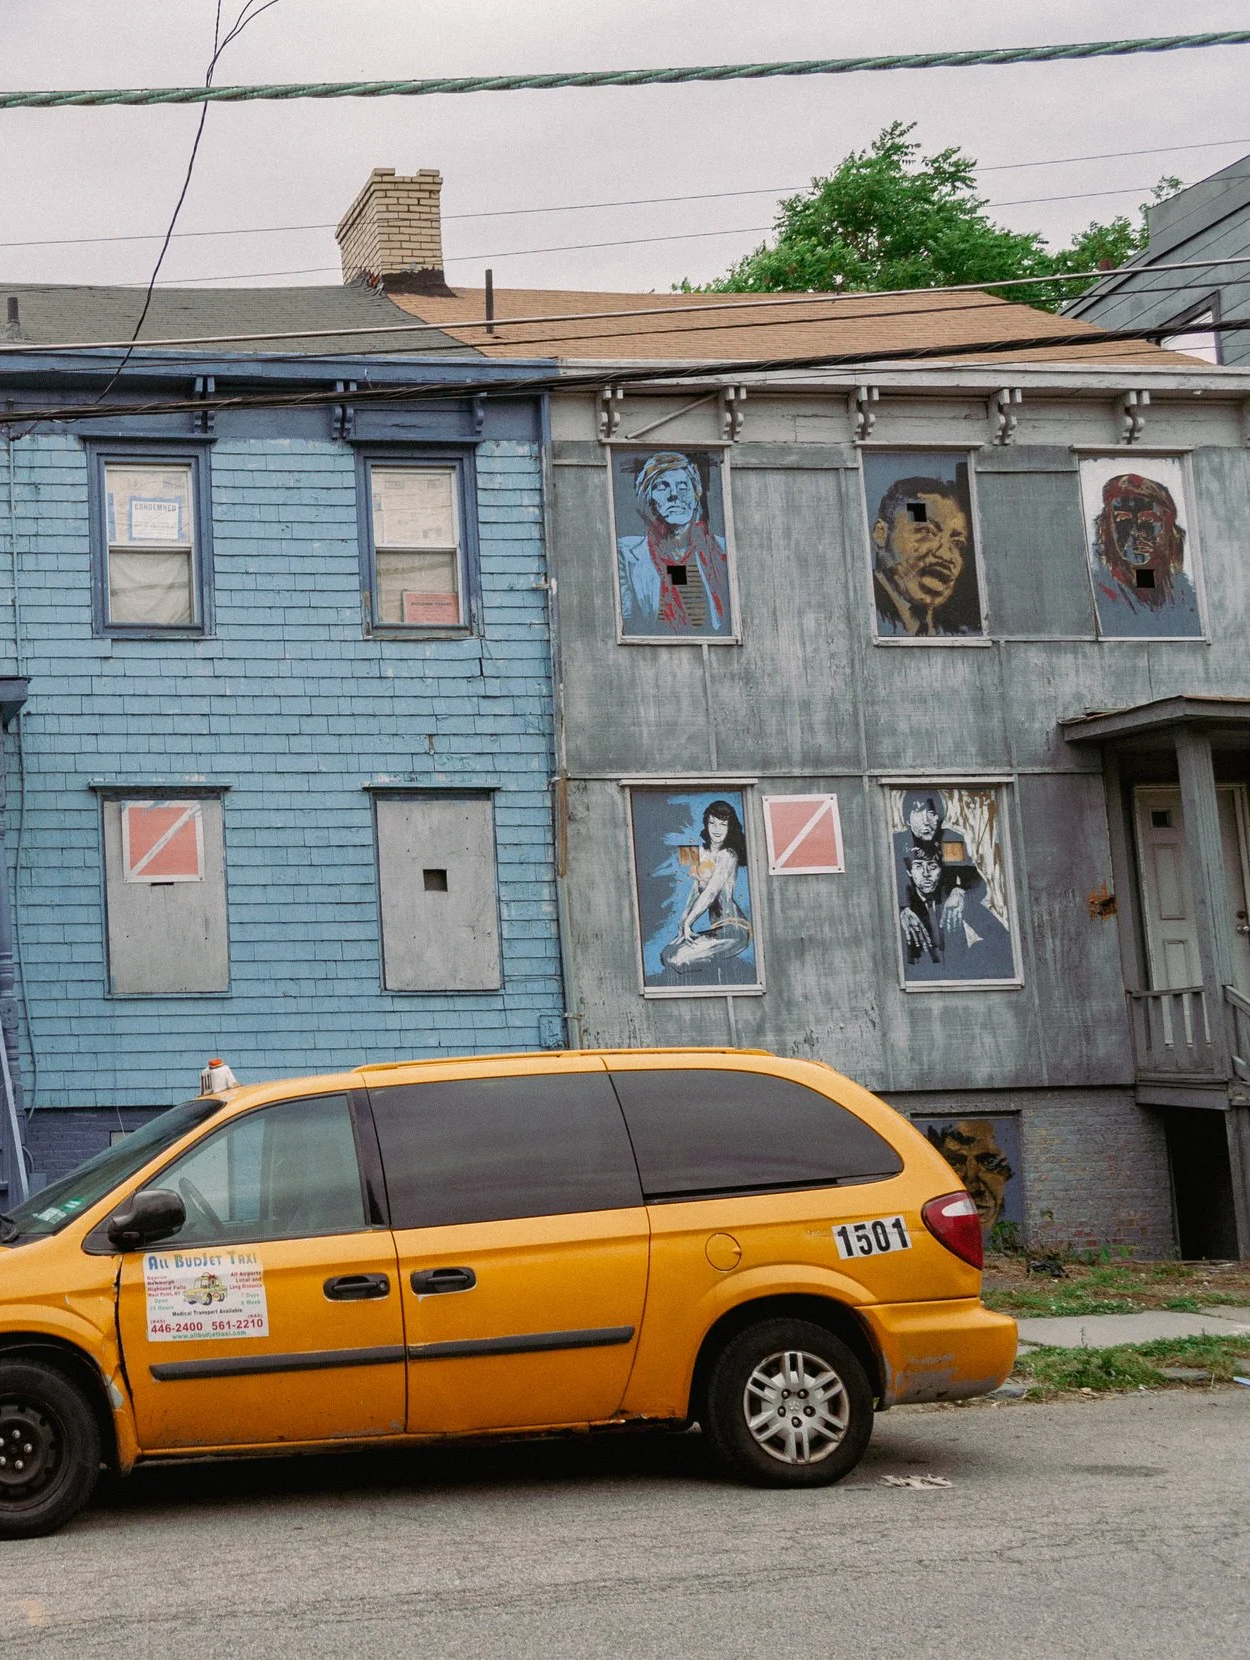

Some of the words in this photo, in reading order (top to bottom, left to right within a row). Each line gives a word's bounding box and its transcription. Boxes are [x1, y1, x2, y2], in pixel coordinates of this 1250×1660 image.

[134, 503, 177, 512] CONDEMNED
[837, 1217, 909, 1257] 1501
[193, 1309, 218, 1317] Transport
[150, 1322, 203, 1334] 446-2400
[212, 1318, 264, 1331] 561-2210
